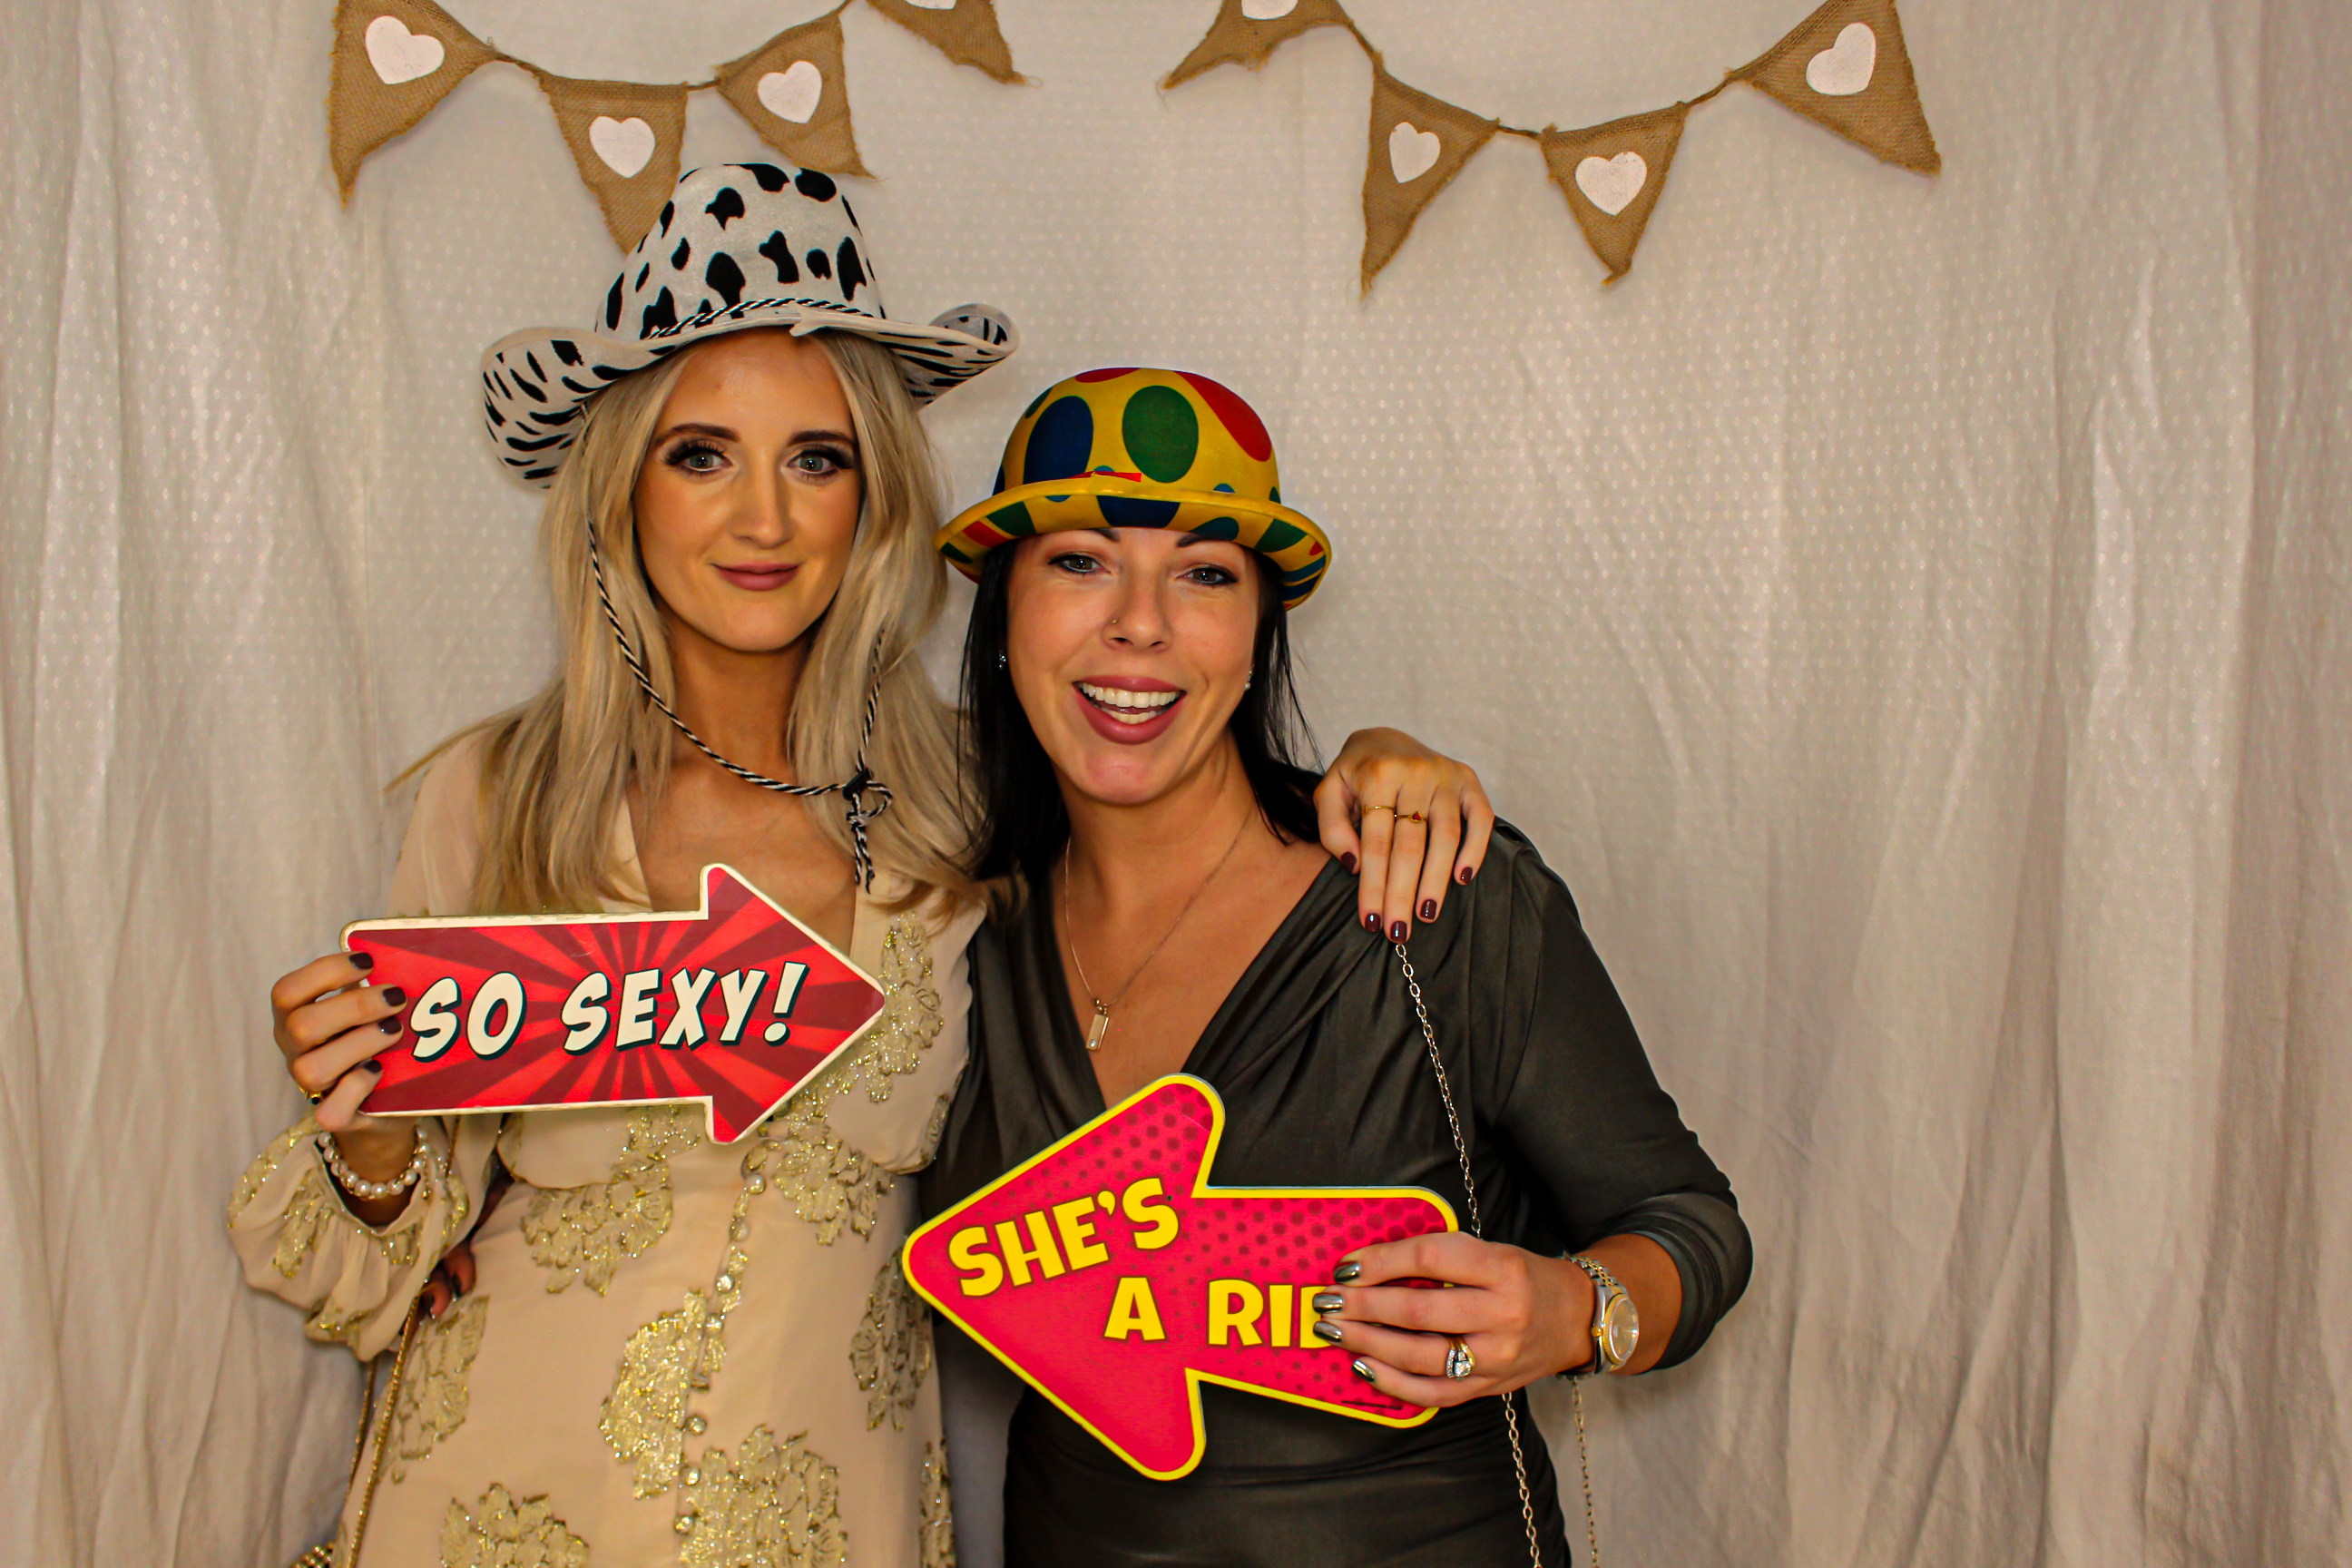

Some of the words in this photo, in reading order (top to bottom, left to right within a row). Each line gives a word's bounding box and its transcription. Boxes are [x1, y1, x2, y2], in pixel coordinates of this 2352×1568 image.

[410, 971, 526, 1063] SO
[560, 962, 808, 1055] SEXY!
[948, 1178, 1180, 1297] SHE'S
[1104, 1277, 1166, 1341] A
